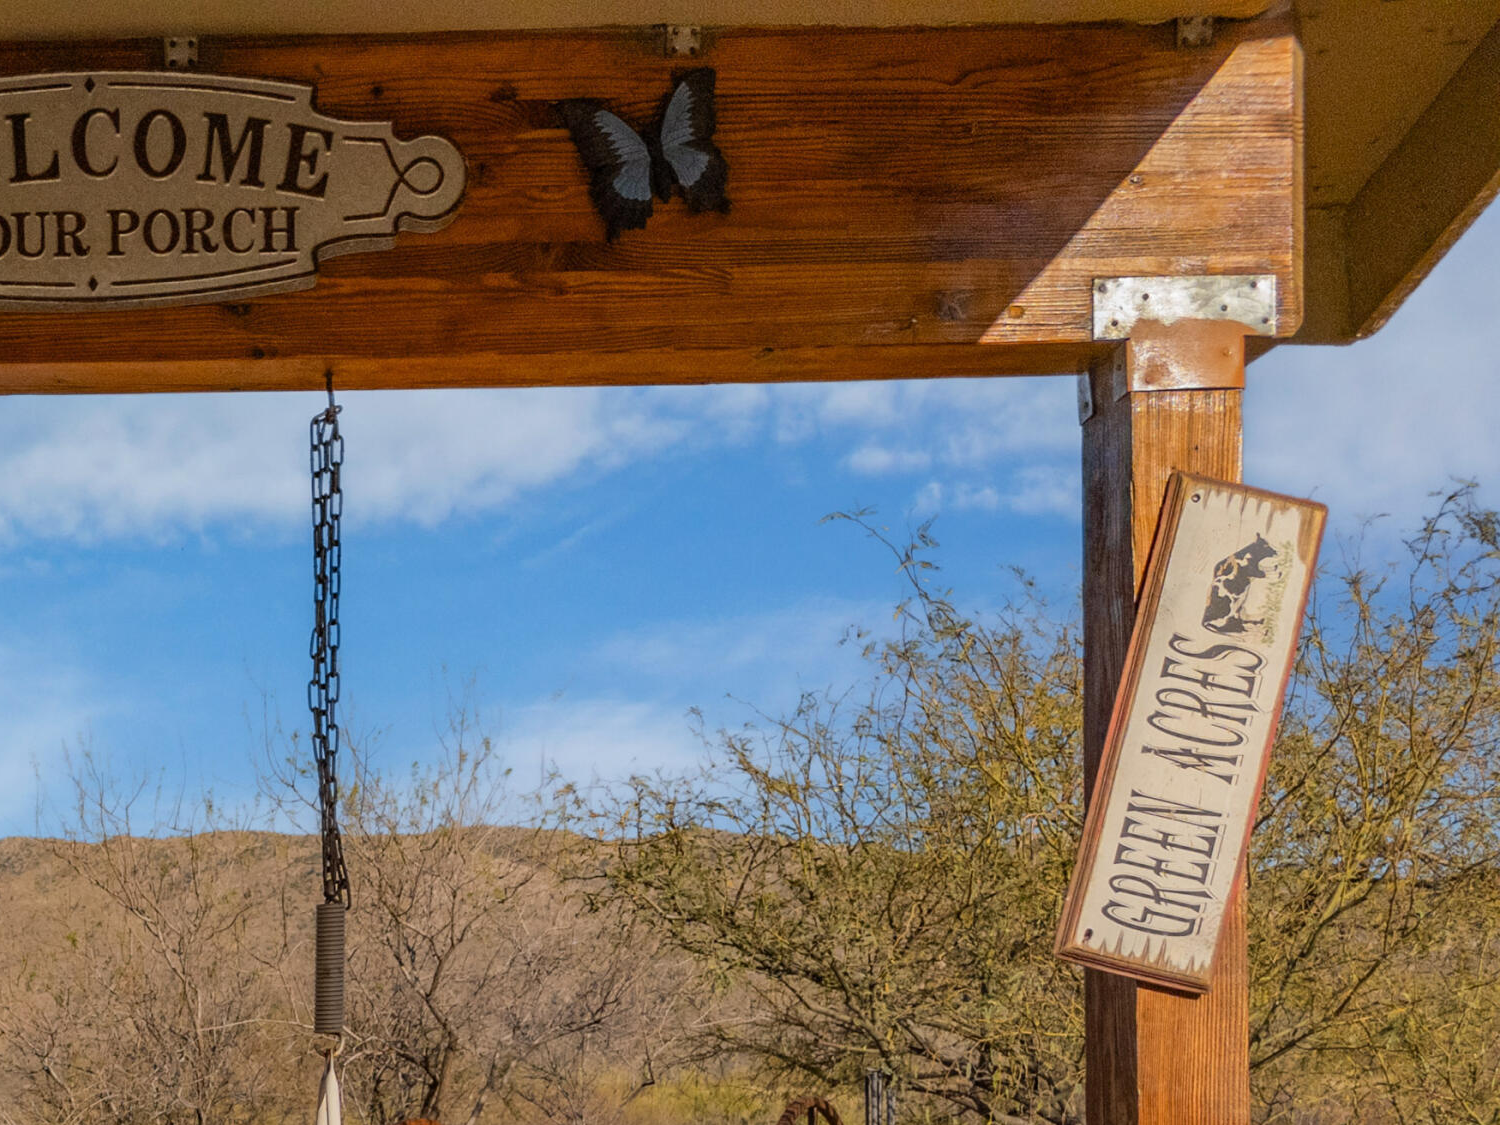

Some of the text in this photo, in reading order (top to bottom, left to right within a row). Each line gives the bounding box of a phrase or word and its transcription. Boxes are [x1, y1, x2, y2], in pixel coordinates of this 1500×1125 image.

[106, 207, 300, 255] PORCH
[1101, 634, 1264, 936] GREEN ACRES
